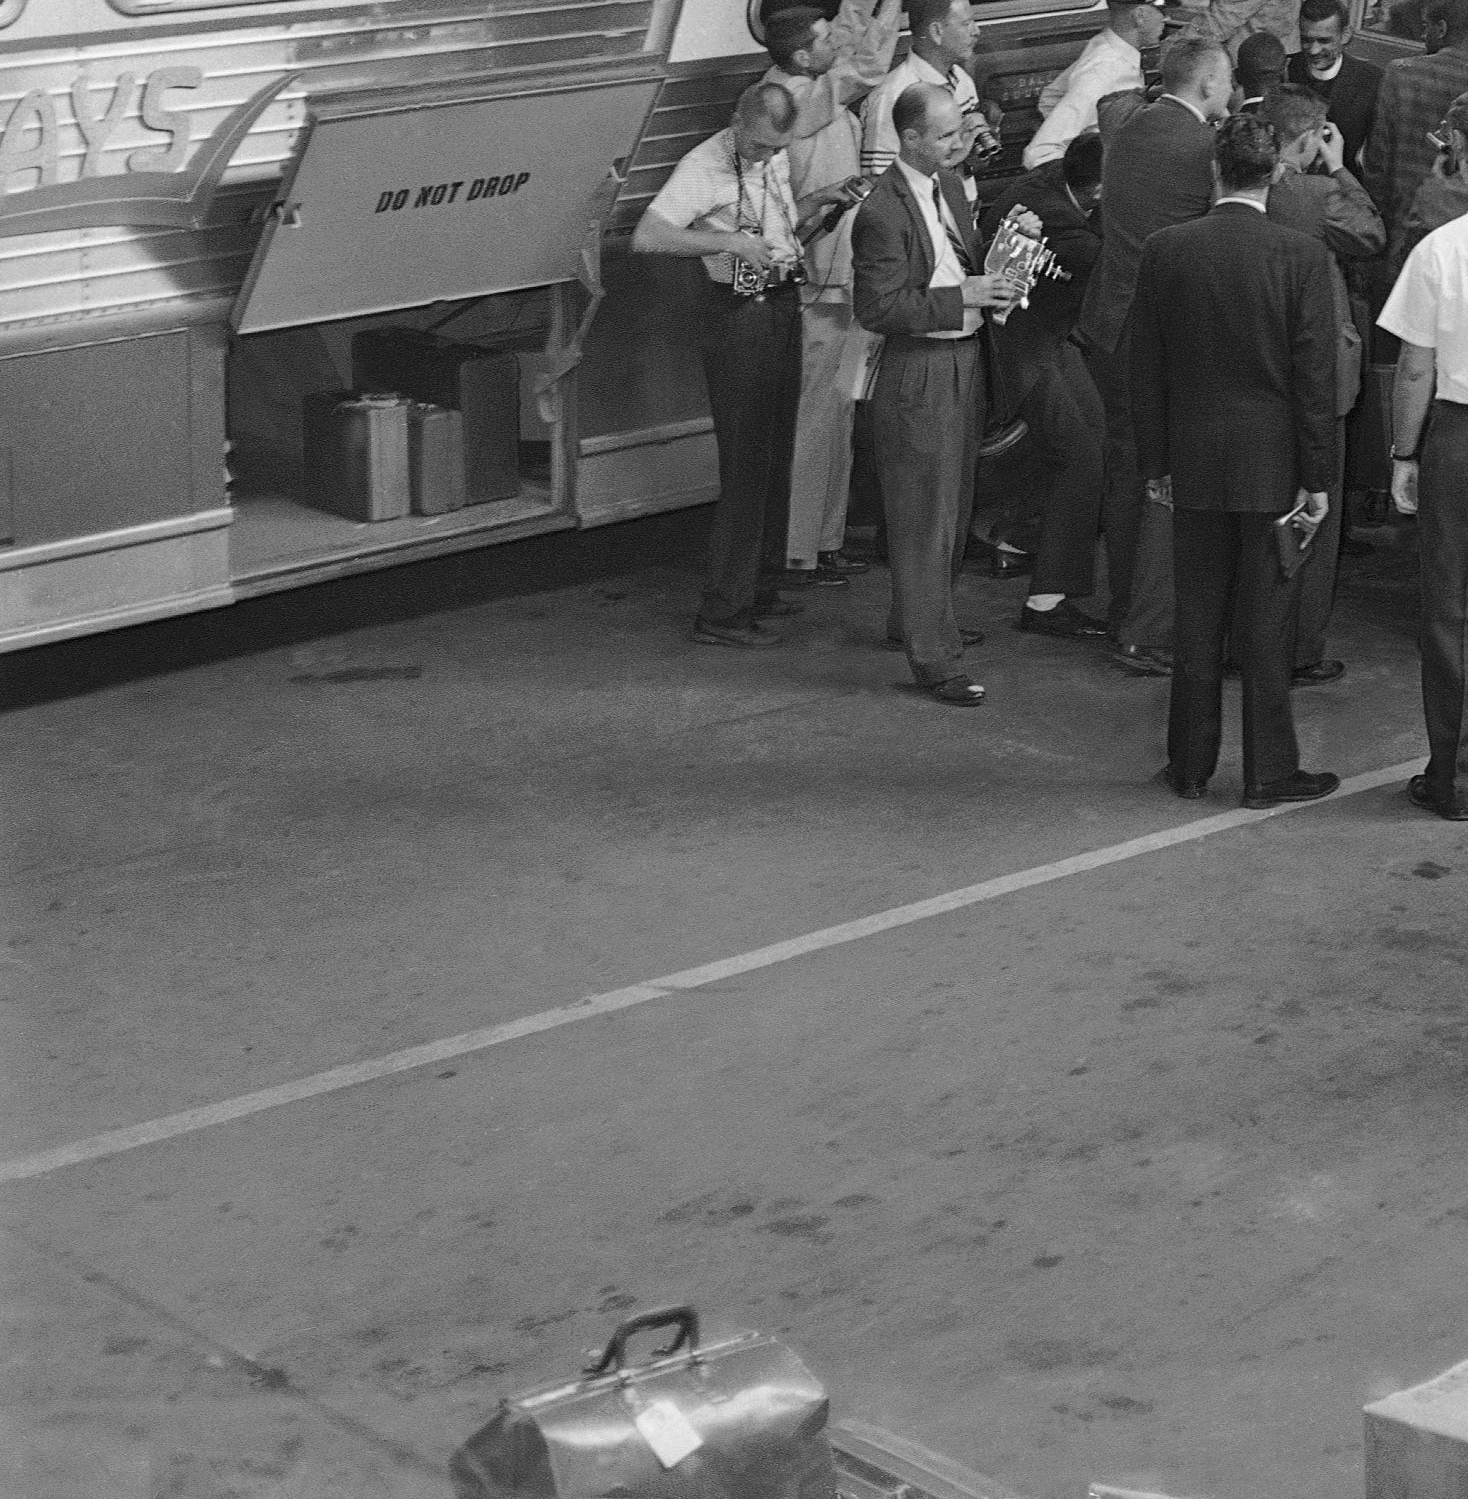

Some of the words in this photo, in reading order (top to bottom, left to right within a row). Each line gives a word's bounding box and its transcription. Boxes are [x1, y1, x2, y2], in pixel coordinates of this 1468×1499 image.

[0, 65, 203, 193] AYS
[375, 189, 409, 214] DO
[414, 181, 463, 209] NOT
[467, 172, 531, 201] DROP
